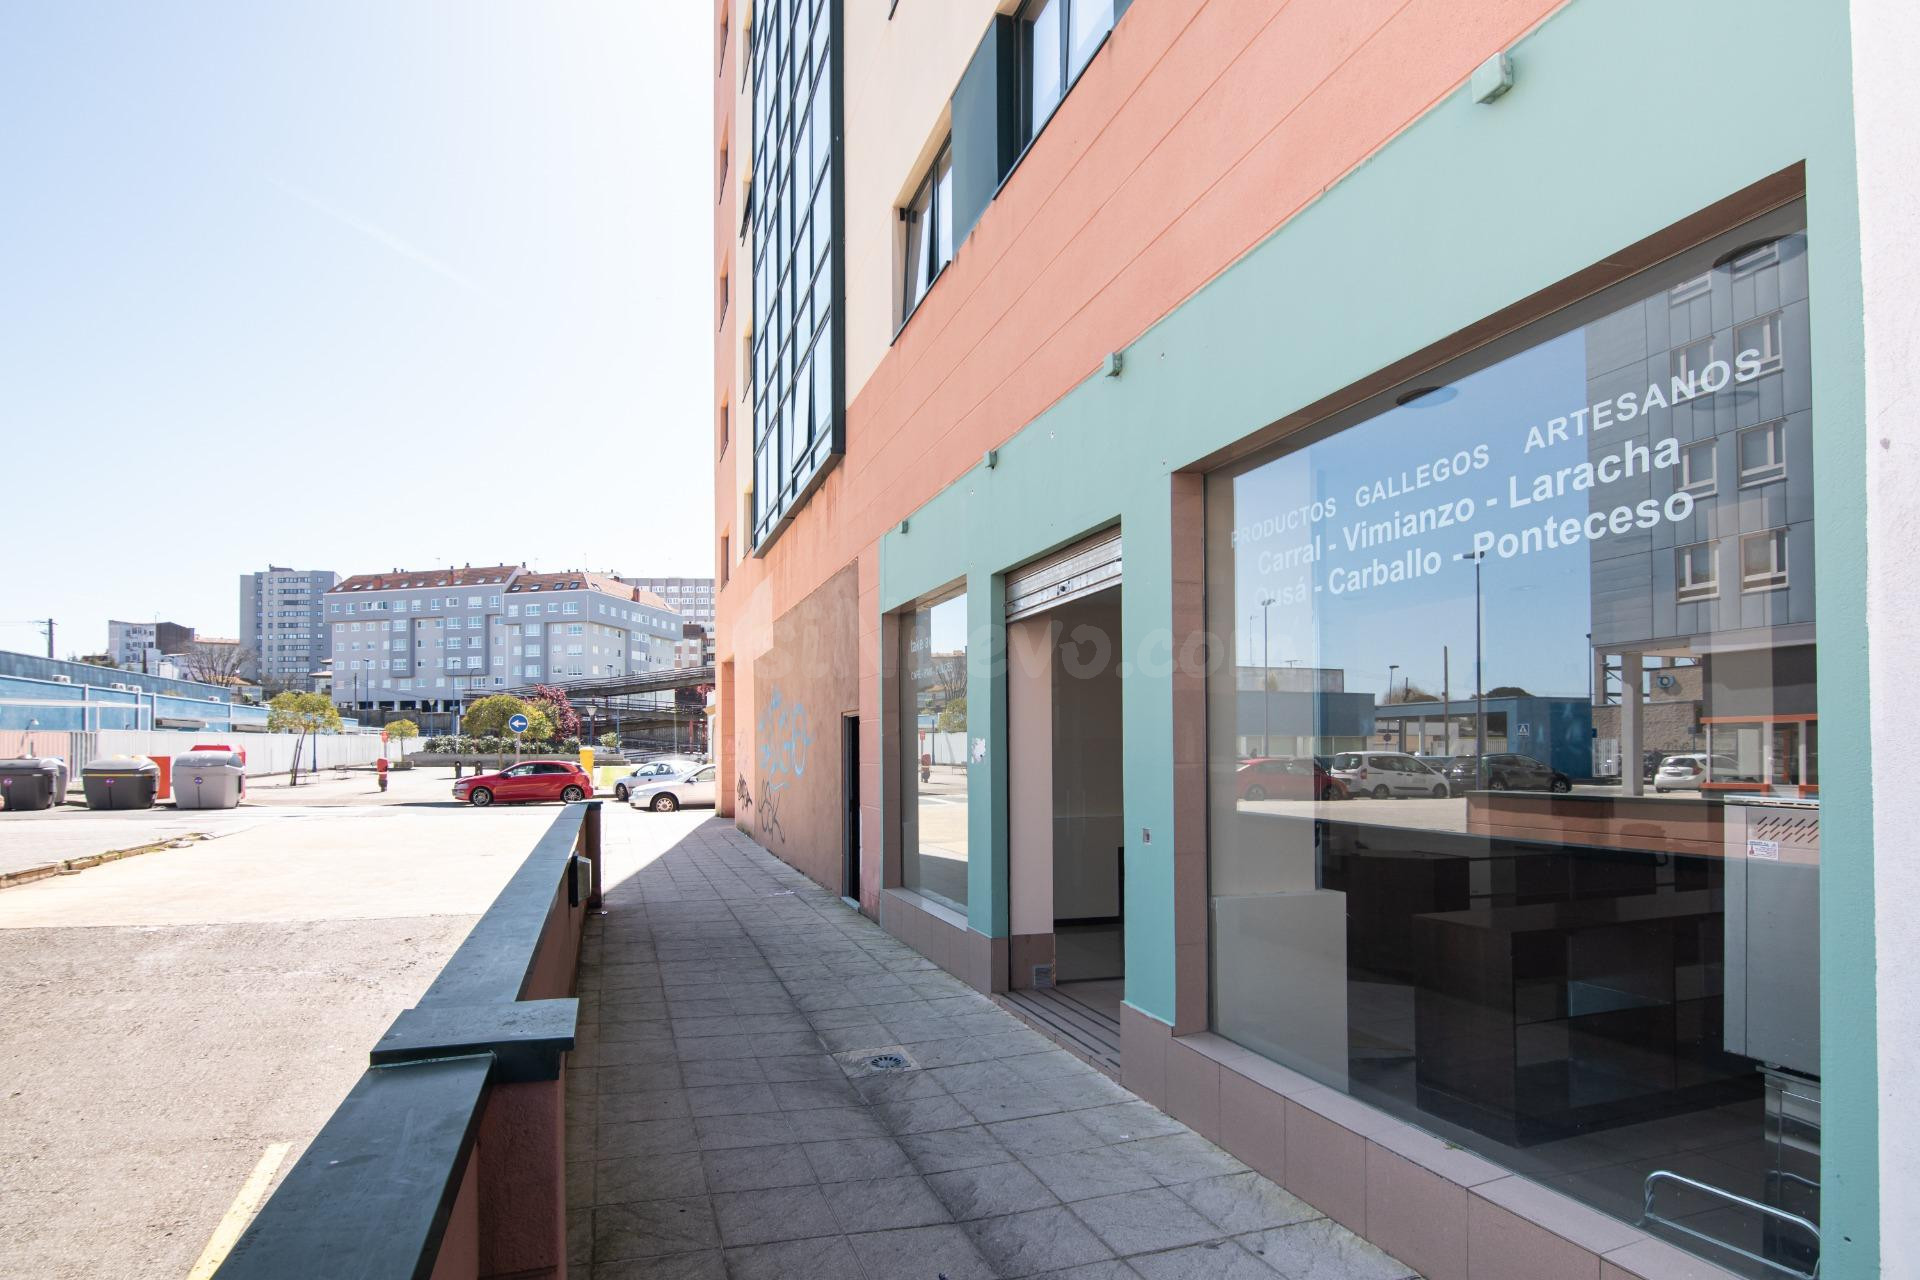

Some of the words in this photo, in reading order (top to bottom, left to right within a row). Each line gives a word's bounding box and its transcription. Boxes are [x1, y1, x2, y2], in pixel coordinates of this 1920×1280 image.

[1231, 497, 1336, 549] PRODUCTOS
[1355, 444, 1489, 507] GALLEGOS
[1523, 348, 1761, 454] ARTESANOS
[1259, 534, 1321, 575] Carral
[1342, 497, 1475, 552] Vimianzo
[1509, 437, 1680, 509] Laracha
[1329, 548, 1442, 595] Carballo
[1474, 491, 1694, 565] Ponteceso
